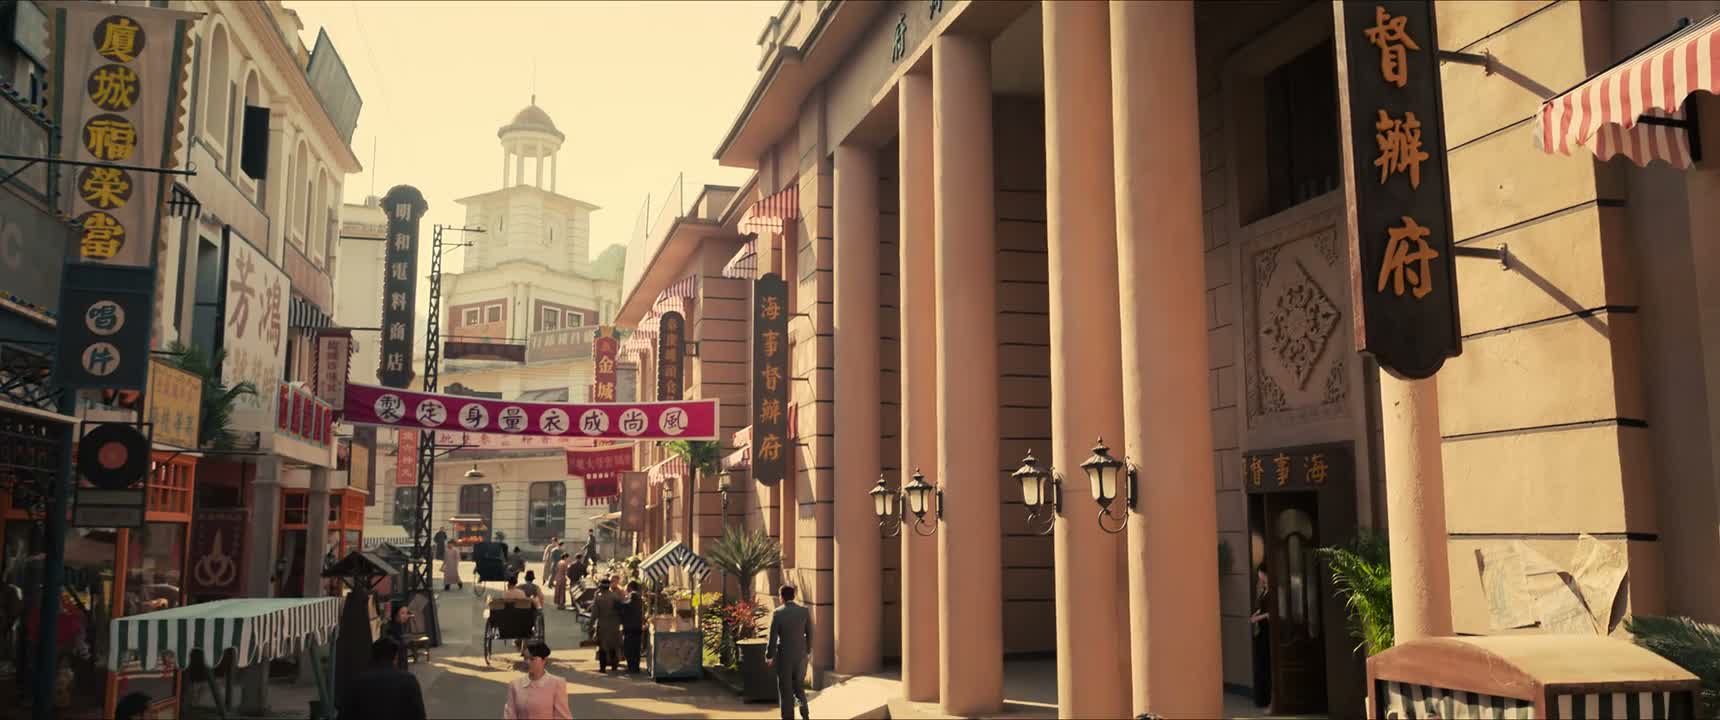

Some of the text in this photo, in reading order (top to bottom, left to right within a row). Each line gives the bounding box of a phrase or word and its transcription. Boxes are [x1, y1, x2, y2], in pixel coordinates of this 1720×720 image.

[80, 18, 139, 260] 廈城福榮當
[88, 305, 119, 371] 唱片
[387, 202, 412, 373] 明和電料商店
[759, 295, 783, 464] 海事督辦府
